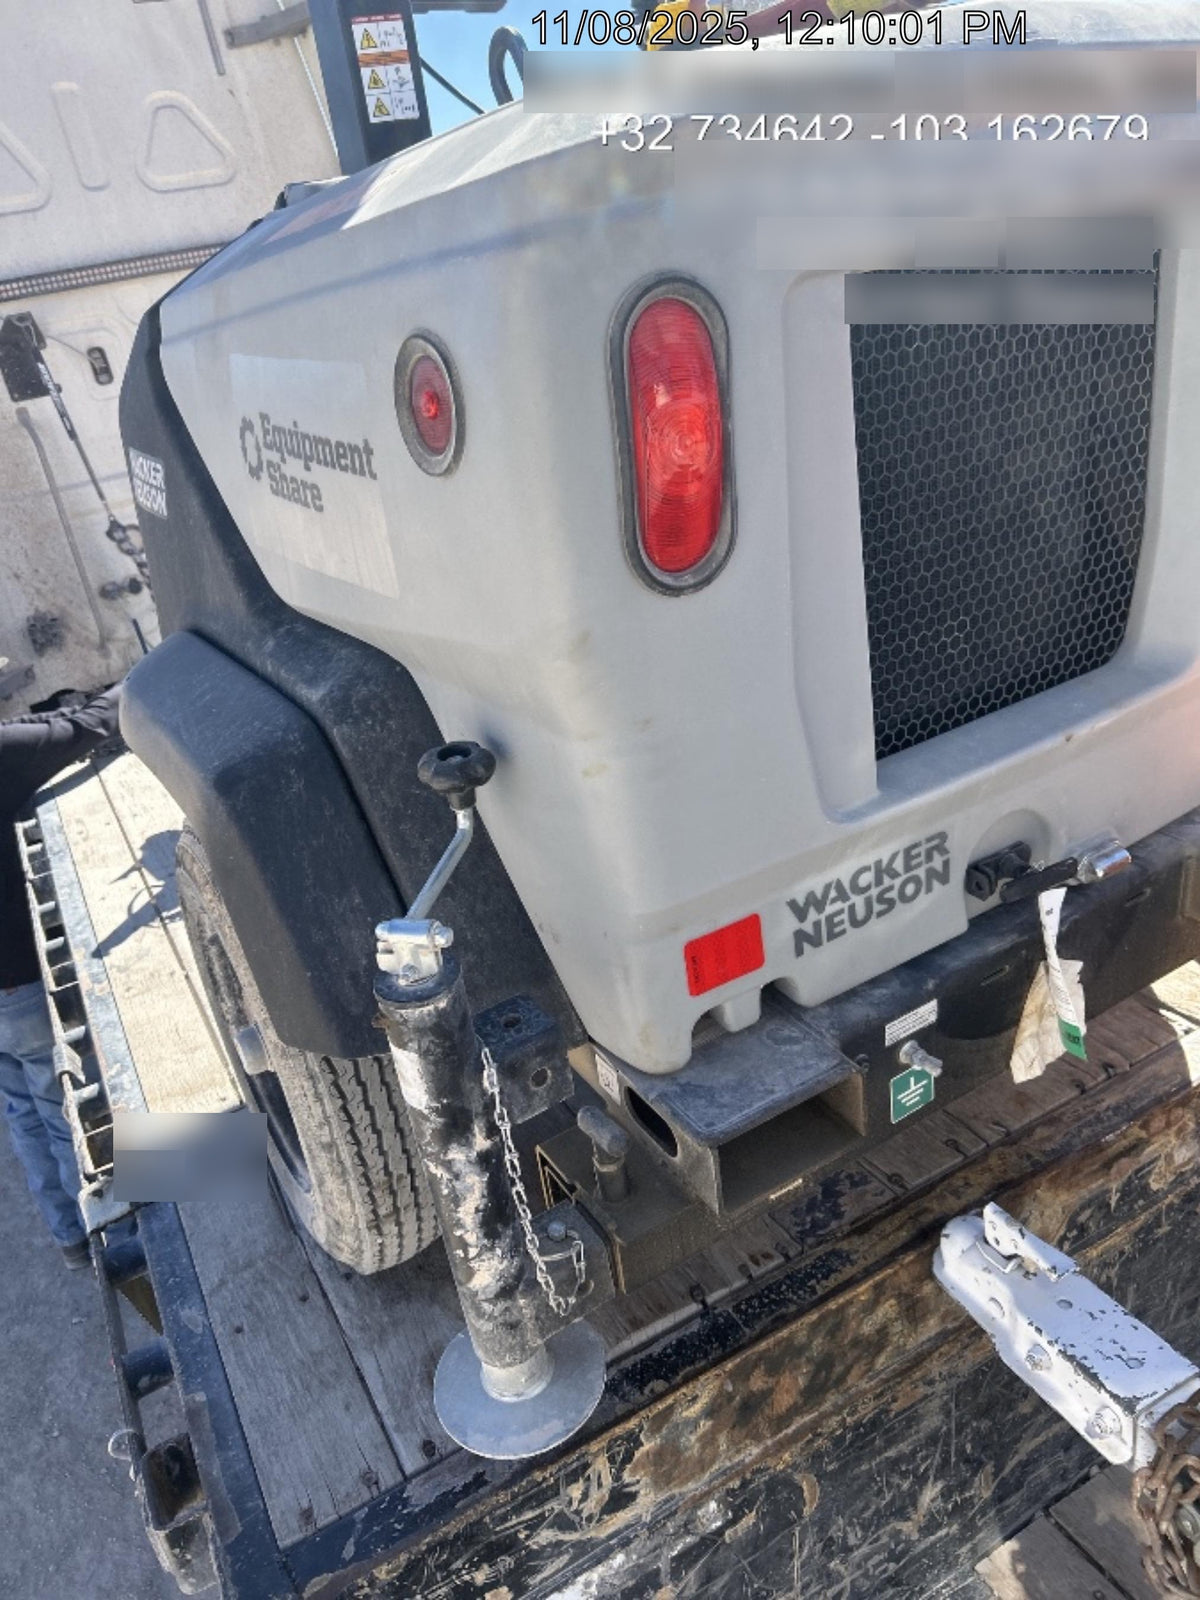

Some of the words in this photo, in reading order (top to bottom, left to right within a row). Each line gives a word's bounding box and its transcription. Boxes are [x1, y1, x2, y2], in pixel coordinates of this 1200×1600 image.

[258, 411, 378, 481] Equipment
[265, 459, 324, 513] Share
[785, 830, 951, 924] WACKER
[792, 857, 951, 959] NEUSON
